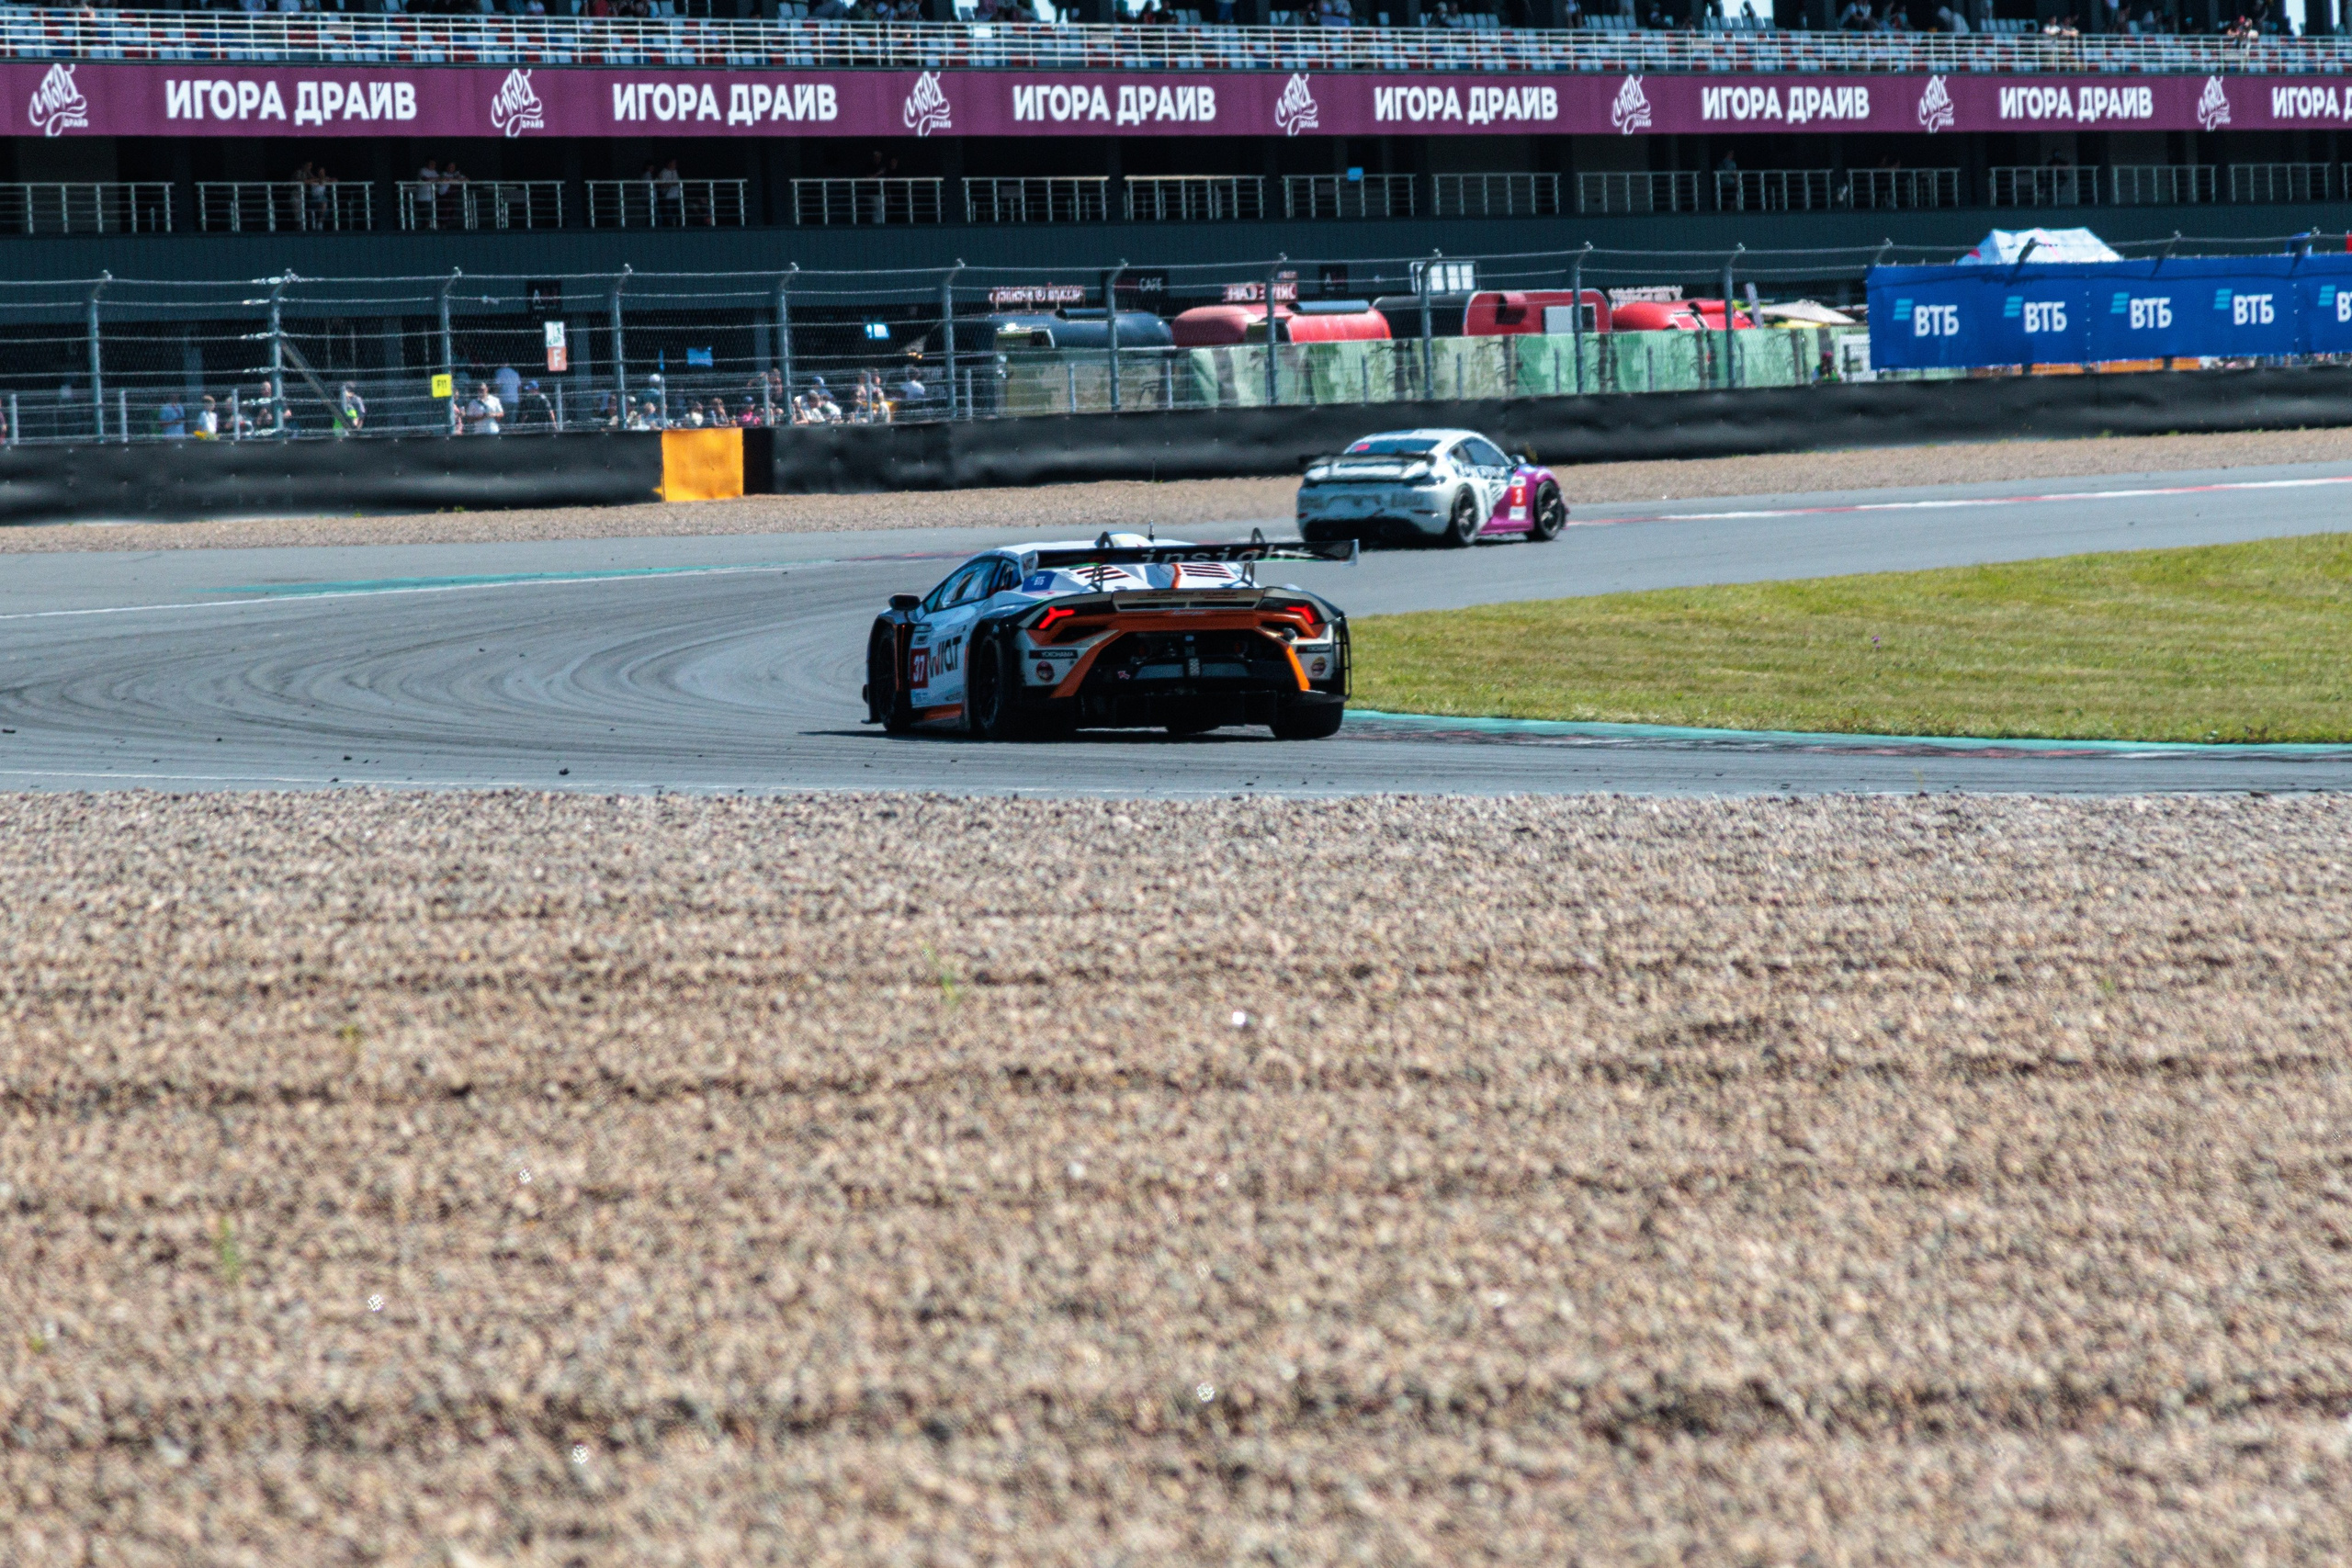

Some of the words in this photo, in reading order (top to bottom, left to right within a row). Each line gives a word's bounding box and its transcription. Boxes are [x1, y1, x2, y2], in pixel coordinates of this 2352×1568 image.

[166, 80, 287, 122] ИГОРА
[295, 82, 418, 128] ДРАЙВ
[613, 84, 721, 122] ИГОРА
[728, 85, 839, 128] ДРАЙВ
[1013, 85, 1113, 122] ИГОРА
[1117, 85, 1217, 127] ДРАЙВ
[1374, 86, 1464, 122] ИГОРА
[1468, 87, 1559, 126] ДРАЙВ
[1702, 87, 1784, 121] ИГОРА
[1787, 87, 1871, 125] ДРАЙВ
[2000, 86, 2075, 120] ИГОРА
[2078, 86, 2154, 124] ДРАЙВ
[2272, 86, 2341, 119] ИГОРА
[1914, 304, 1960, 337] ВТБ
[2023, 301, 2067, 333] ВТБ
[2130, 297, 2172, 329] ВТБ
[2233, 293, 2274, 325] ВТБ
[912, 654, 926, 682] 37
